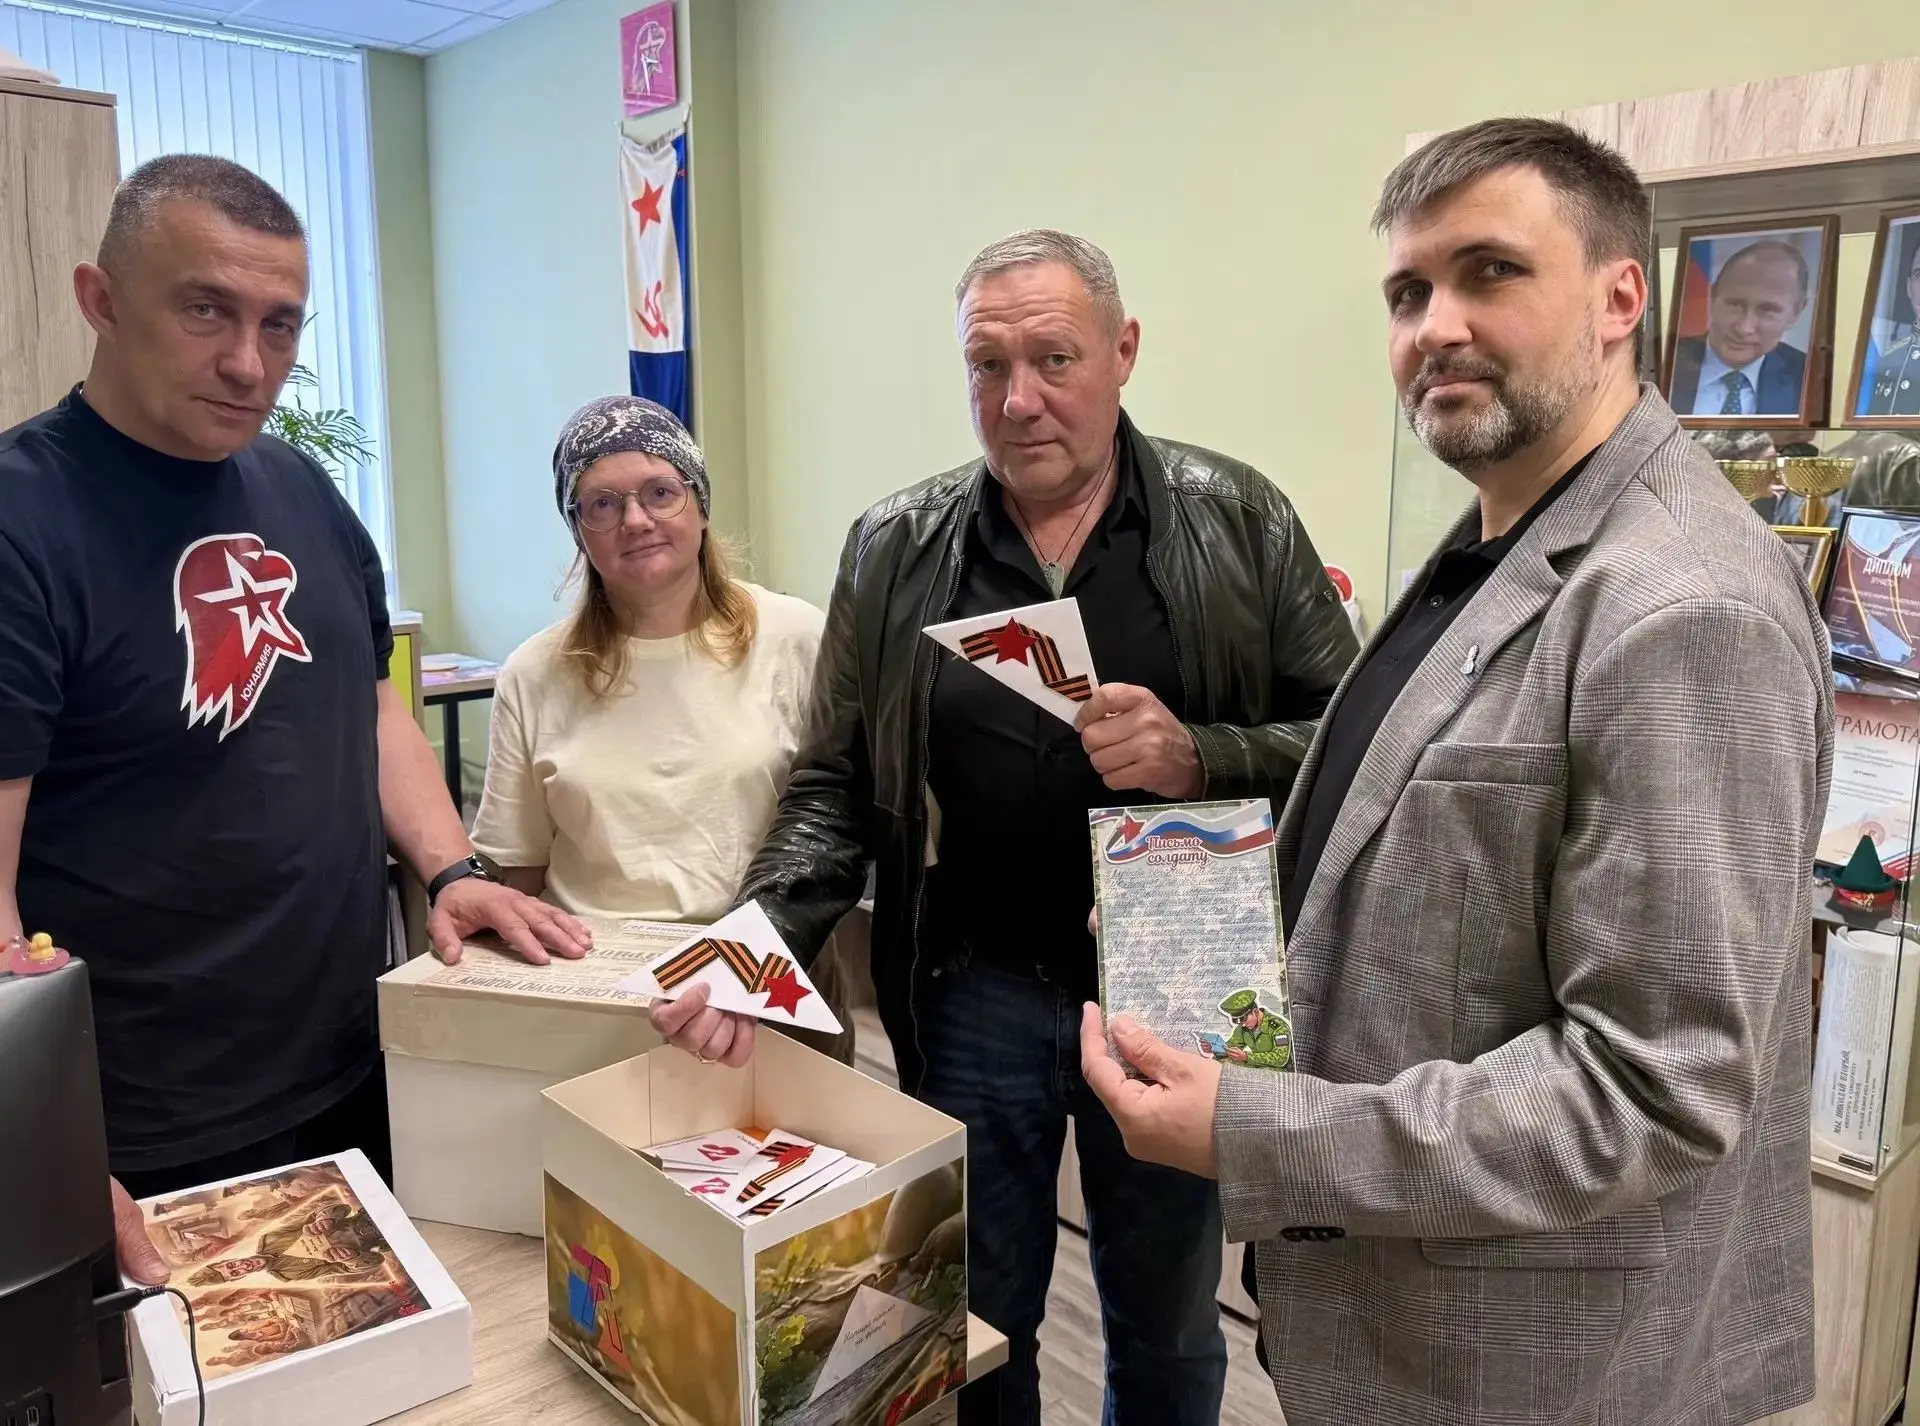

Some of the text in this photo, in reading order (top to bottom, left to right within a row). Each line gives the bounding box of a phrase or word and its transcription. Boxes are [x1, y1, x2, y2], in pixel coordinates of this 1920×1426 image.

[1862, 557, 1912, 579] ДИПЛОМ
[240, 643, 273, 702] ЮНАРМИЯ
[1146, 836, 1202, 851] Письмо
[1147, 850, 1209, 869] солдату
[455, 975, 520, 990] РОДИНУ
[518, 981, 612, 998] СОВЕТСКУЮ
